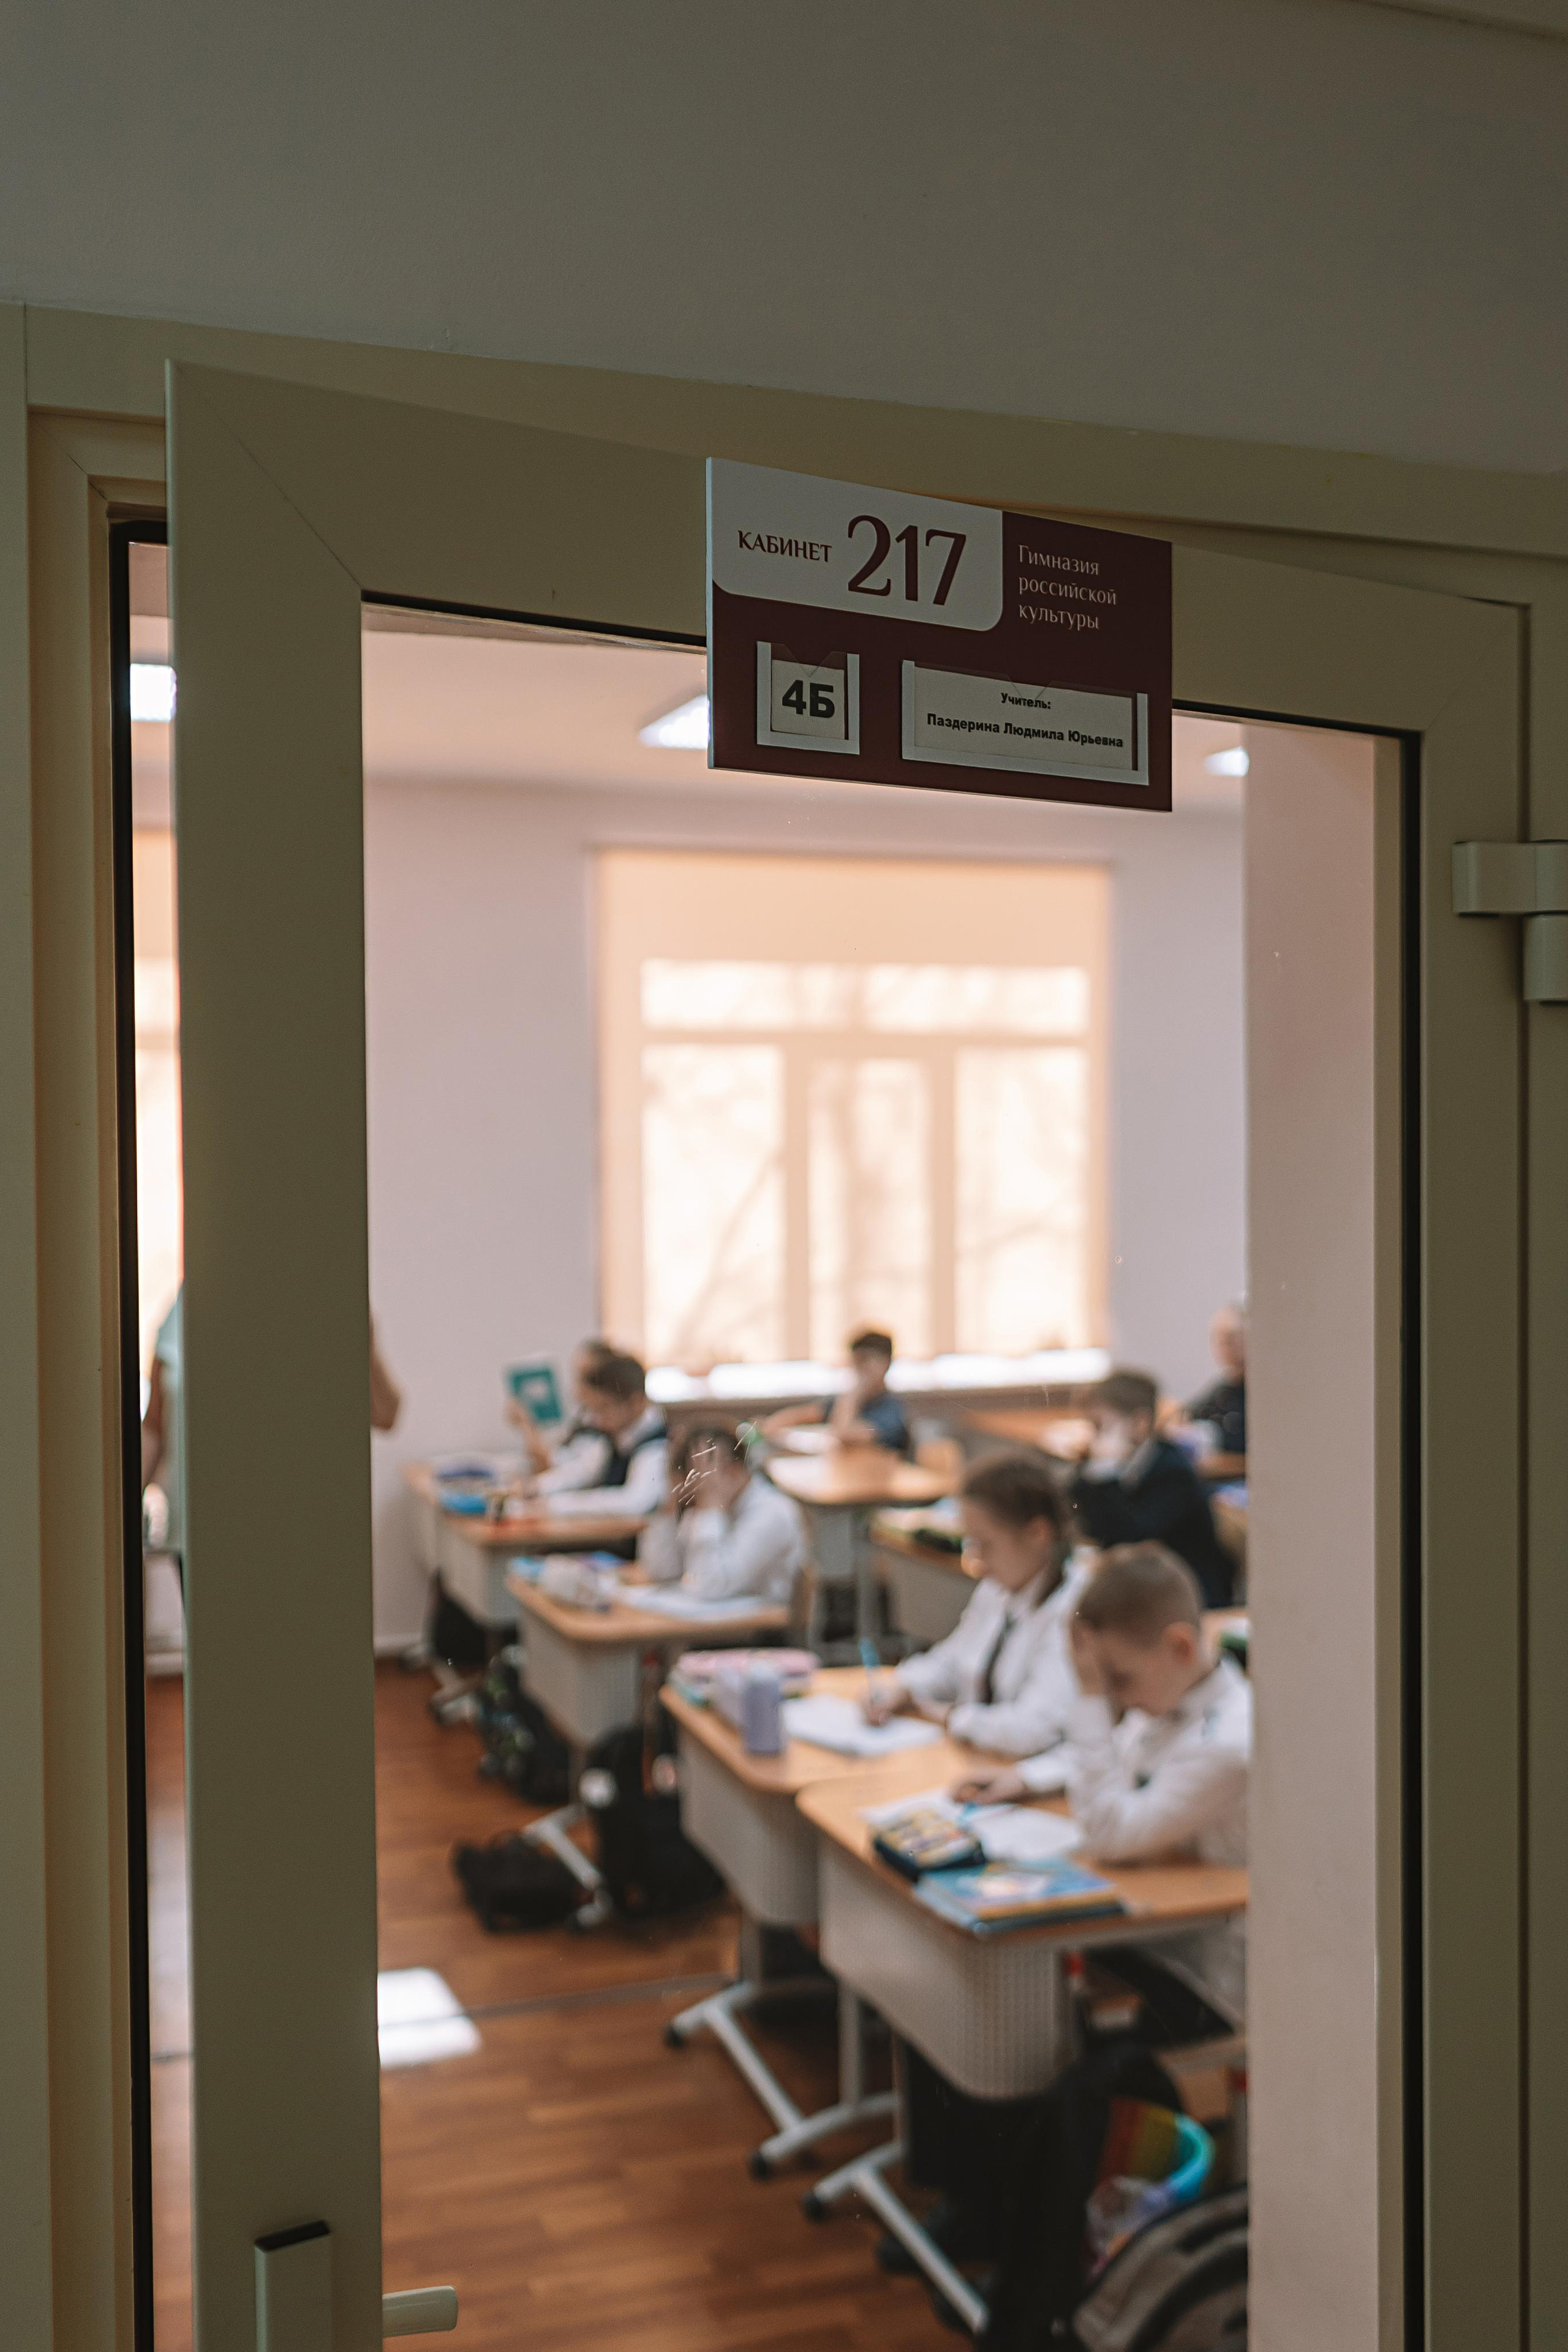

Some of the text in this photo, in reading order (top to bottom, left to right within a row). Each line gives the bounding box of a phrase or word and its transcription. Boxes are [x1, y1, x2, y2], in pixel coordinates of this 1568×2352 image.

[737, 515, 967, 605] КАБИНЕТ 217
[1019, 545, 1099, 575] Гимназия
[1019, 576, 1117, 605] российской
[1019, 605, 1099, 631] культуры
[782, 679, 835, 718] 4Б
[1001, 693, 1051, 710] Учитель:
[927, 714, 1123, 748] Паздерина Людмила Юрьевна
